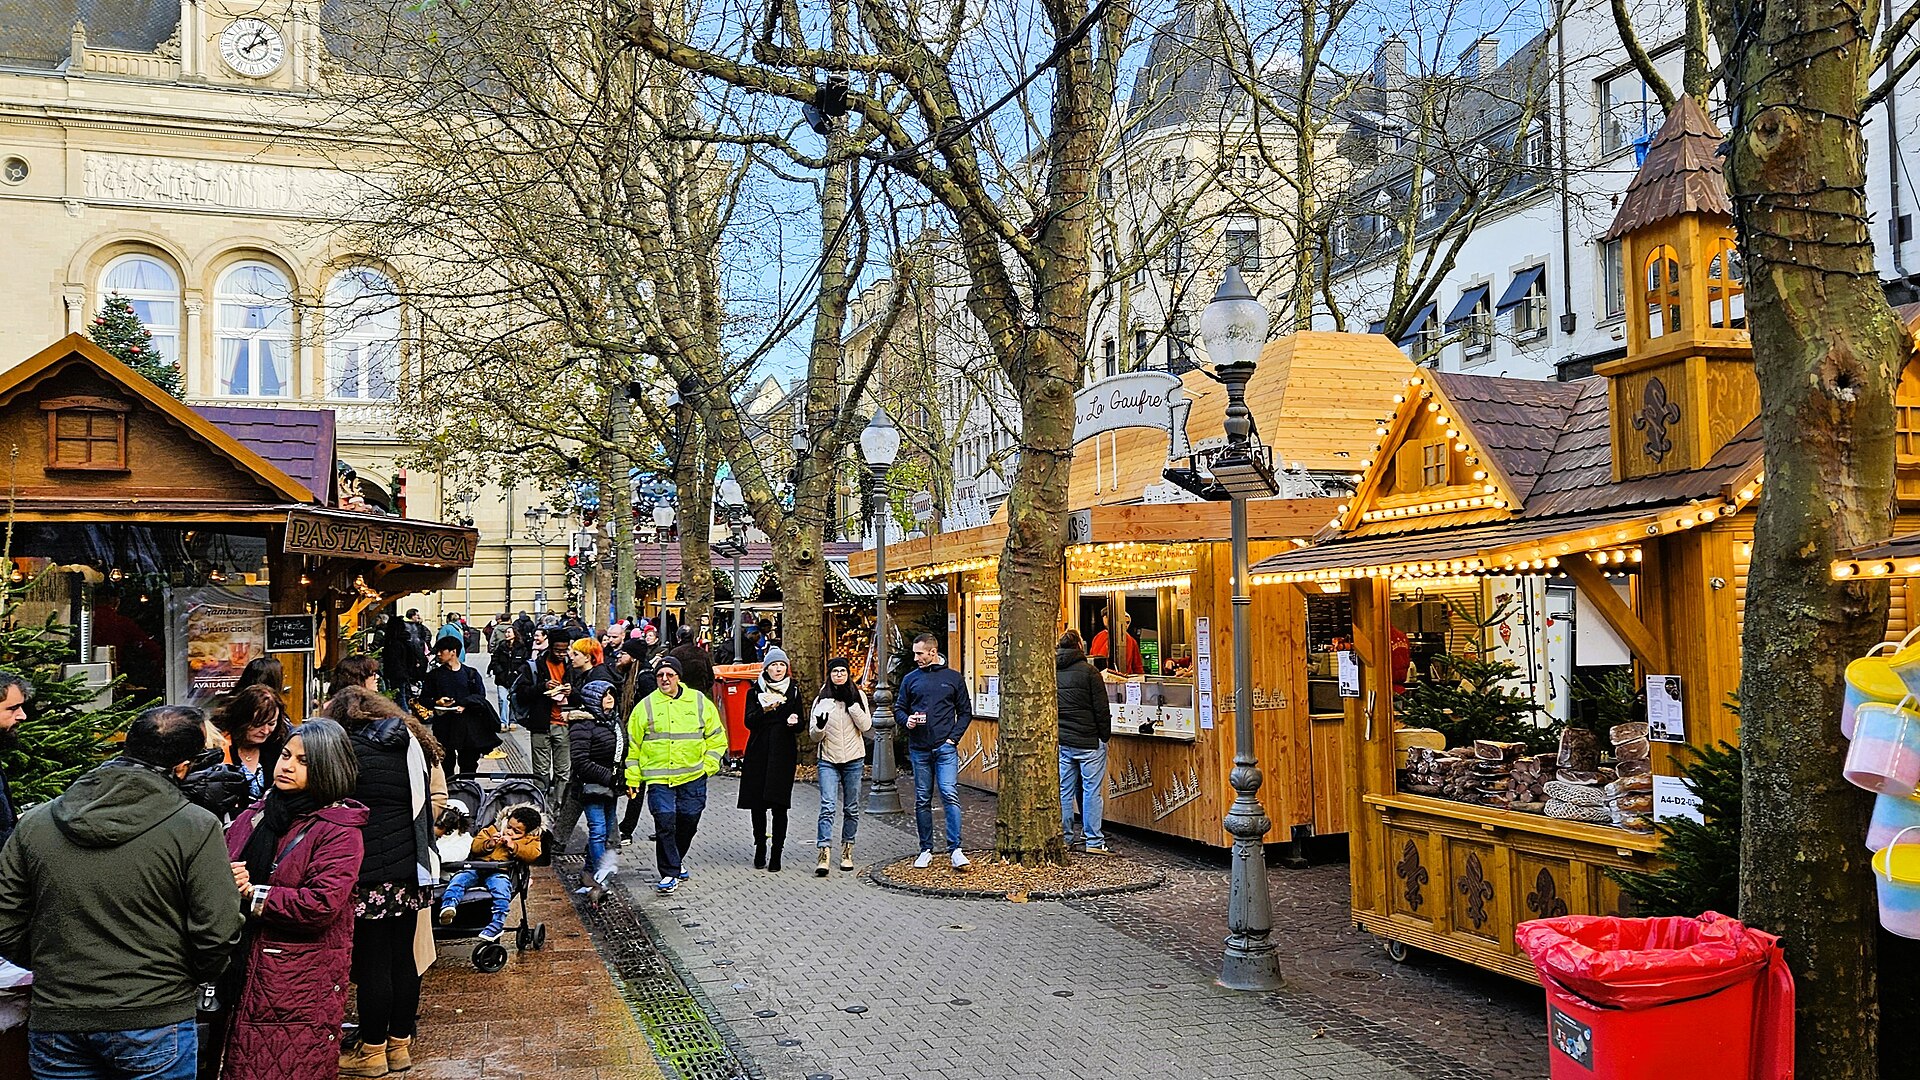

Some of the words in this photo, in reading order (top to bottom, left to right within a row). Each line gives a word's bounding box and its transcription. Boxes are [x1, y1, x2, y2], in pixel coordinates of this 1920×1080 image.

[1086, 396, 1104, 420] La
[1110, 389, 1162, 414] Gaufre
[291, 519, 373, 553] PASTA
[380, 529, 471, 562] FRESCA
[204, 607, 248, 616] Ramborn
